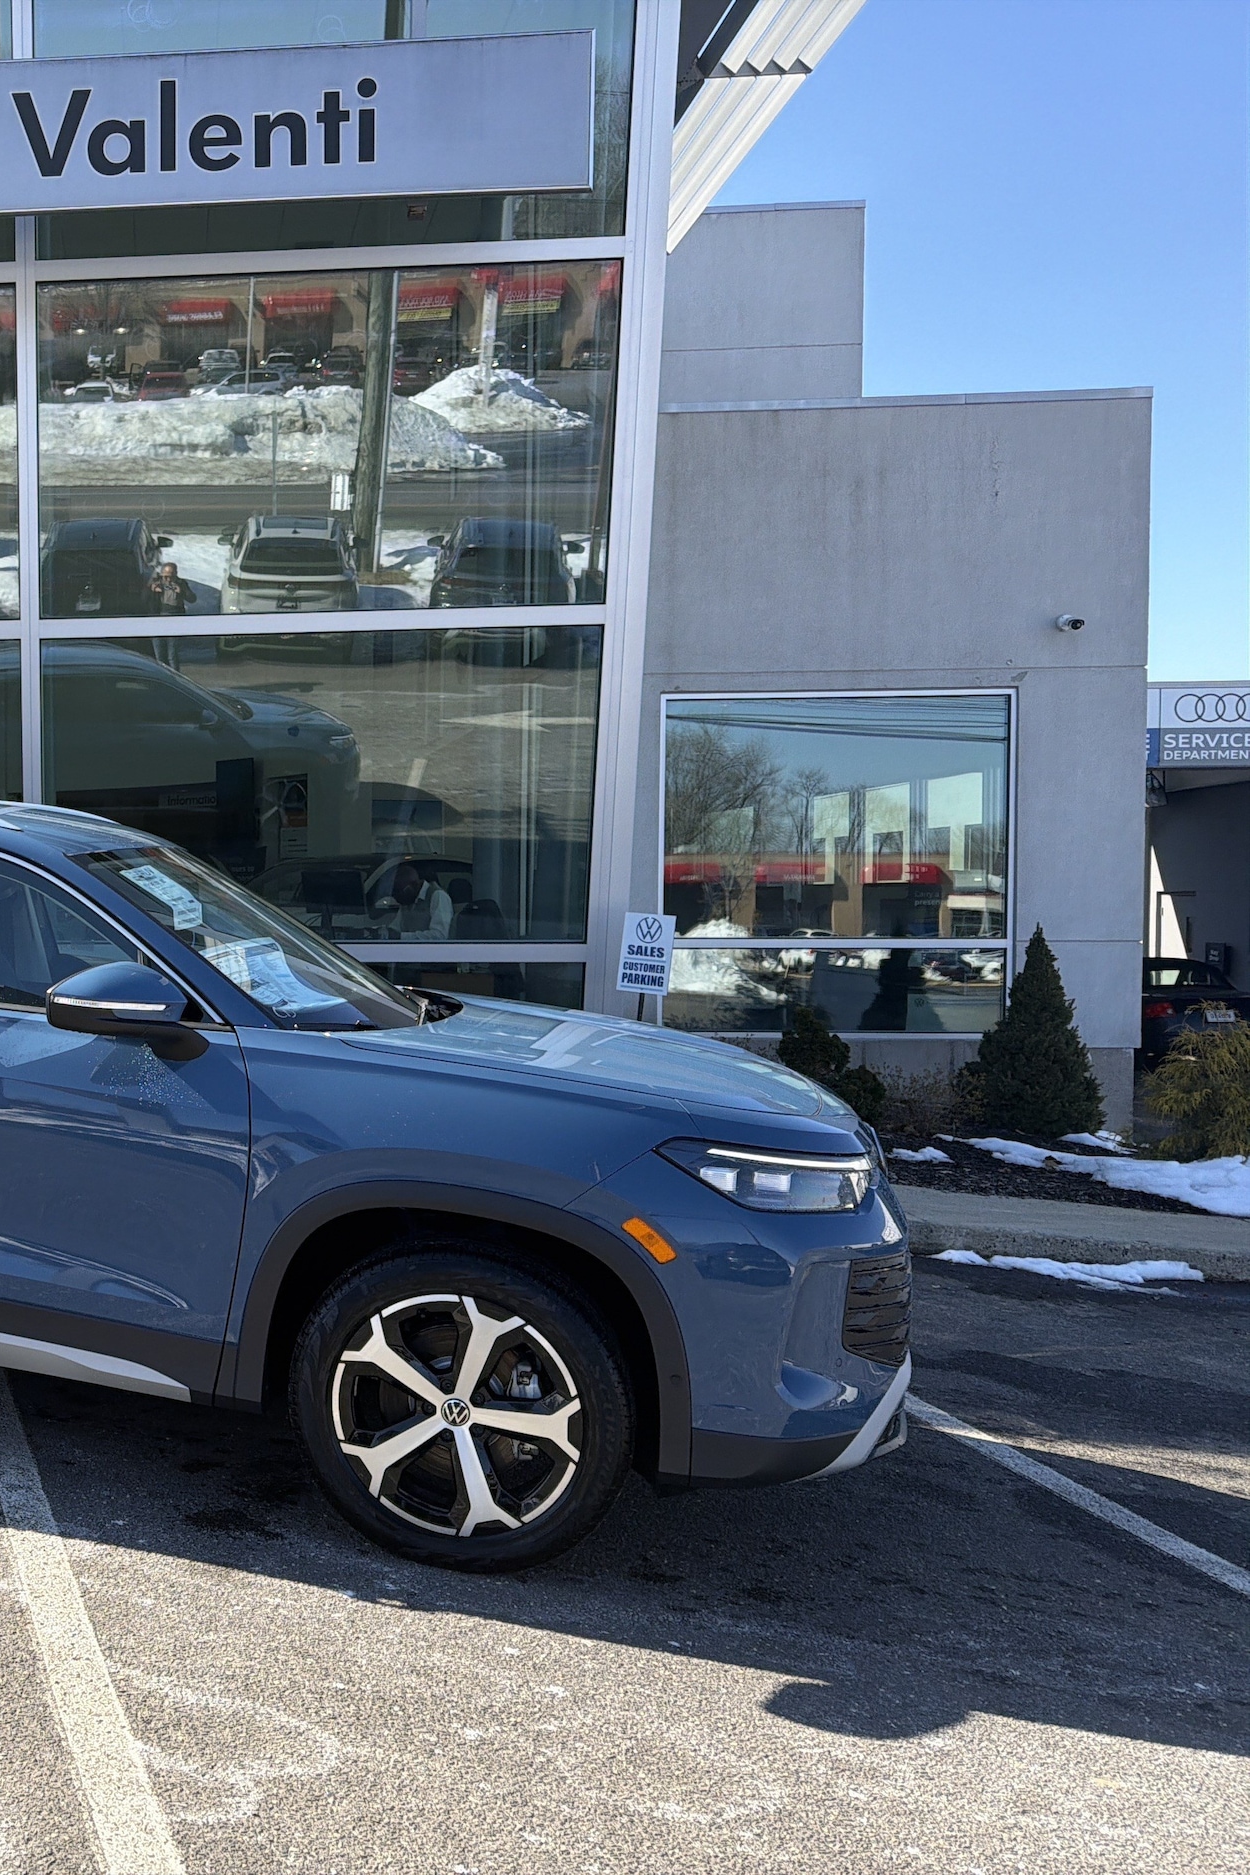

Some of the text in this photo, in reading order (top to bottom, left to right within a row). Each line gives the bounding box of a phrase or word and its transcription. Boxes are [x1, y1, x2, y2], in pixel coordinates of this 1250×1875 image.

[11, 77, 377, 178] Valenti
[627, 944, 665, 958] SALES
[623, 961, 665, 974] CUSTOMER
[621, 972, 664, 987] PARKING
